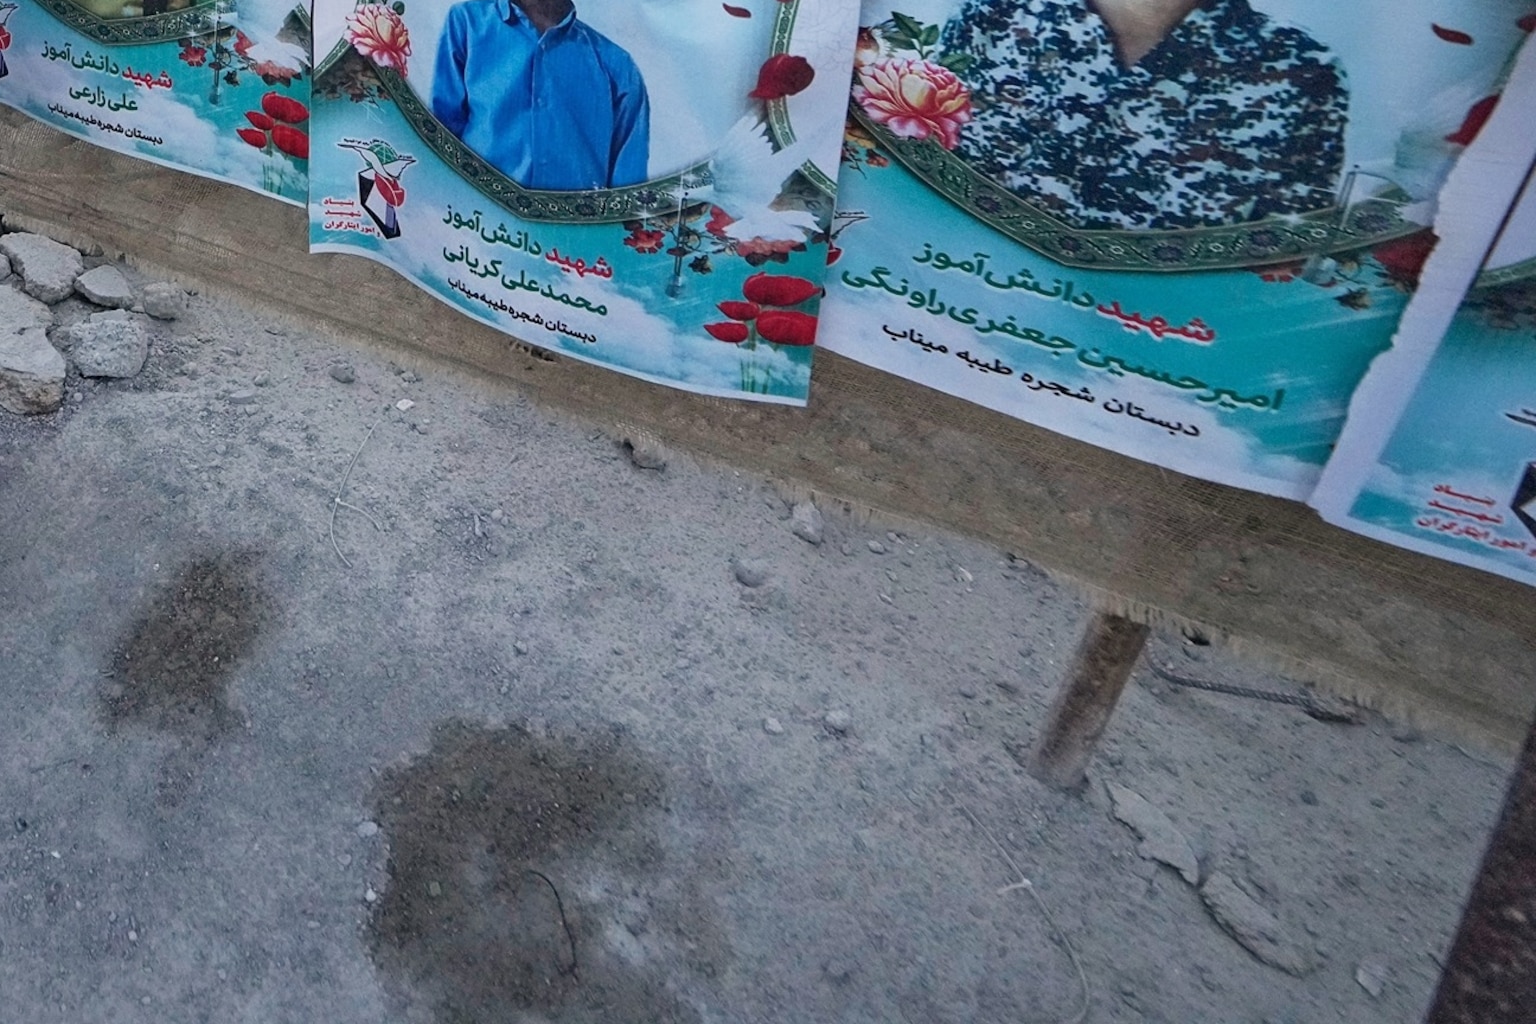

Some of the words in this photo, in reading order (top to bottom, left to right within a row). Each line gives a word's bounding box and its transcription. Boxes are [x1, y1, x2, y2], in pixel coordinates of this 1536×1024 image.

[122, 66, 172, 89] شهید
[69, 85, 106, 108] زارعی
[108, 94, 138, 111] علی
[47, 103, 75, 119] میناب
[75, 112, 99, 127] طیبه
[97, 120, 124, 134] شجره
[125, 128, 163, 145] دبستان
[545, 248, 613, 278] شهید
[447, 276, 479, 299] میناب
[841, 266, 946, 315] راونگی
[480, 293, 509, 312] طیبه
[508, 305, 544, 326] شجره
[1096, 301, 1216, 342] شهید
[545, 320, 597, 344] دبستان
[882, 323, 949, 355] میناب
[948, 305, 1077, 357] جعفری
[956, 350, 1013, 376] طیبه
[1020, 372, 1095, 403] شجره
[1103, 397, 1201, 437] دبستان
